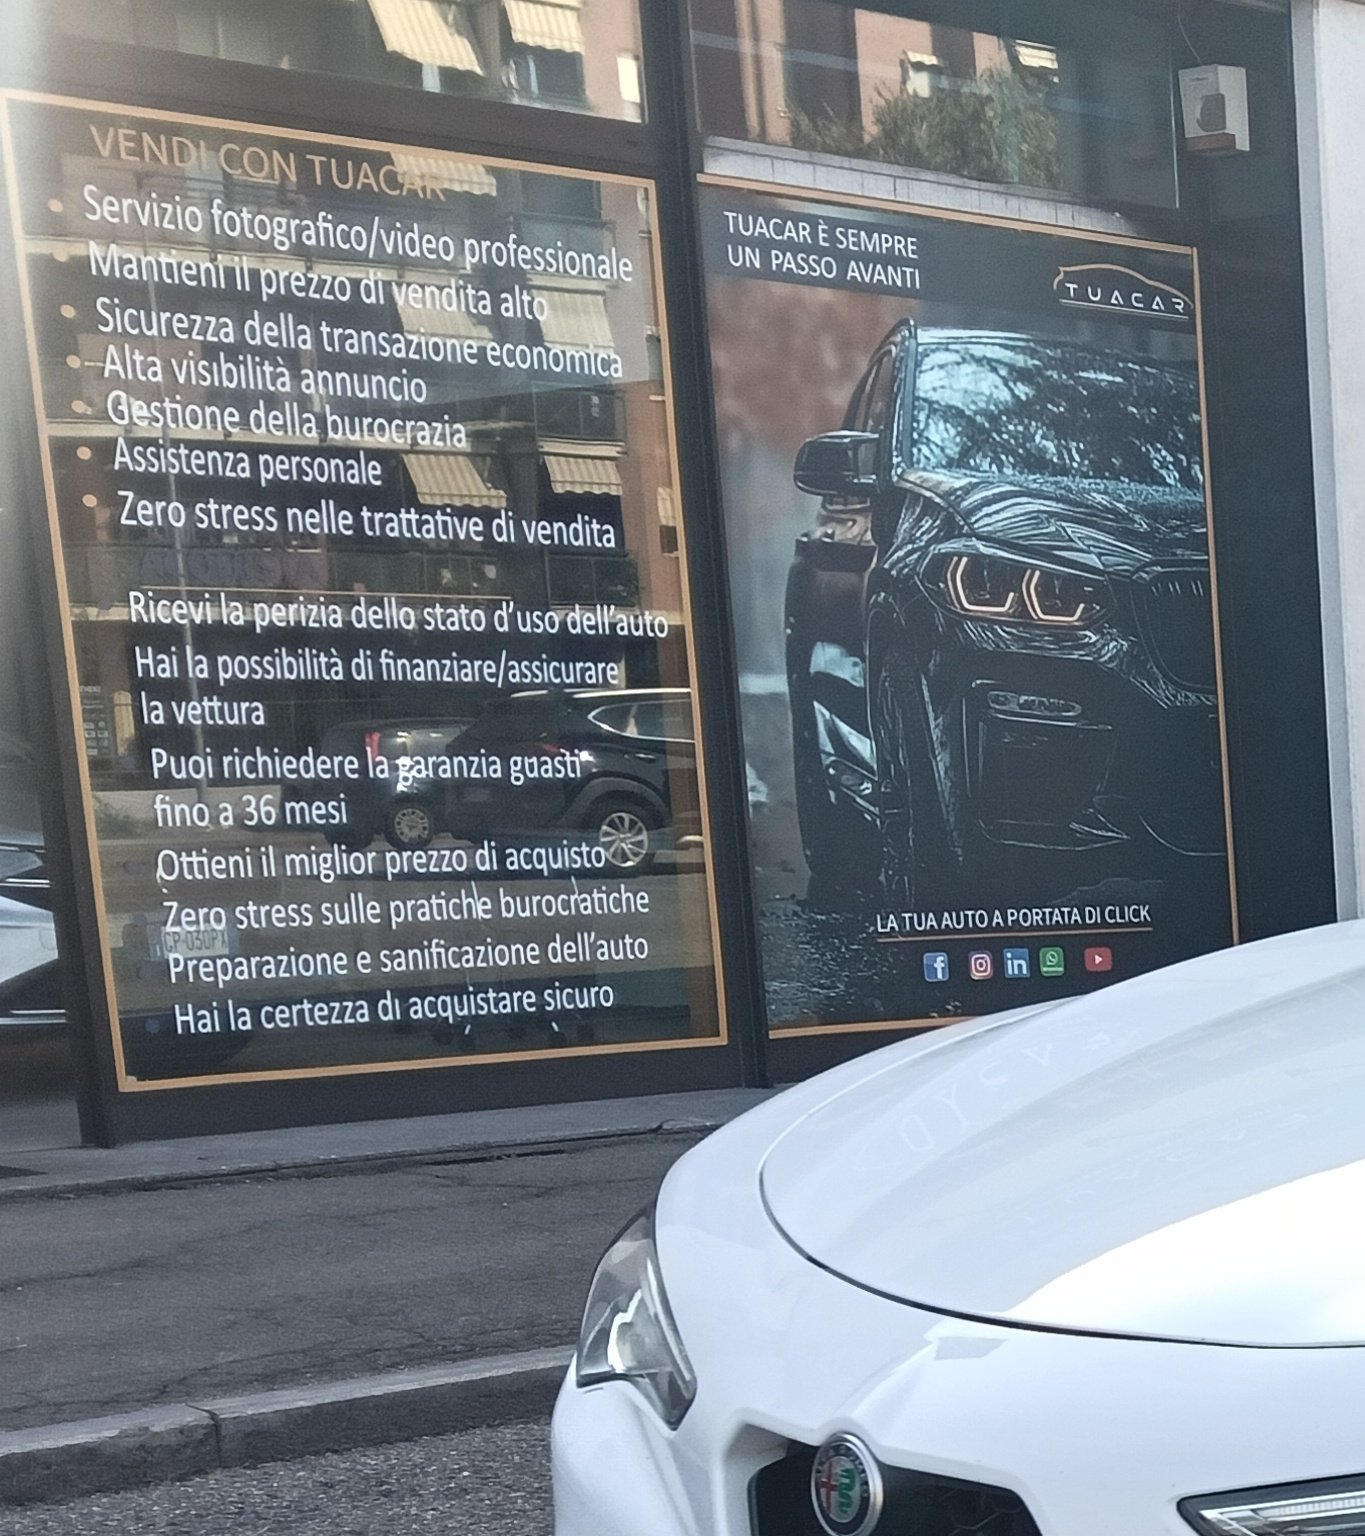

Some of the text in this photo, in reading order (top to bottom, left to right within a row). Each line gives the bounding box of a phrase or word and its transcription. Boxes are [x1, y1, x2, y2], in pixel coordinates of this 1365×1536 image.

[90, 125, 445, 200] VENDI CON TUACAR
[83, 184, 634, 281] Servizio fotografico/video professionale
[723, 211, 918, 258] TUACAR È SEMPRE
[90, 242, 548, 322] Mantieni il prezzo di vendita alto
[727, 245, 920, 289] UN PASSO AVANTI
[1065, 282, 1185, 313] TUACAR
[97, 296, 623, 378] Sicurezza della transazione economica
[104, 345, 427, 403] Alta visibilità annuncio
[107, 391, 467, 448] Gestione della burocrazia
[114, 437, 381, 488] Assistenza personale
[118, 491, 616, 549] Zero stress nelle trattative di vendita
[129, 591, 213, 625] Ricevi
[220, 593, 246, 625] la
[253, 597, 343, 633] perizia
[350, 595, 415, 631] dello
[423, 600, 485, 632] stato
[566, 602, 668, 638] dell'auto
[135, 645, 620, 689] Hai la possibilità di finanziare/assicurare
[141, 692, 264, 725] la vettura
[151, 746, 583, 786] Puoi richiedere la garanzia guasti
[154, 793, 347, 827] fino a 36 mesi
[156, 840, 606, 882] Ottieni il miglior prezzo di acquisto
[163, 884, 649, 932] Zero stress sulle pratiche burocratiche
[877, 904, 1151, 933] LA TUA AUTO A PORTATA DI CLICK
[169, 931, 649, 989] Preparazione e sanificazione dell'auto
[174, 981, 614, 1034] Hai la certezza di acquistare sicuro
